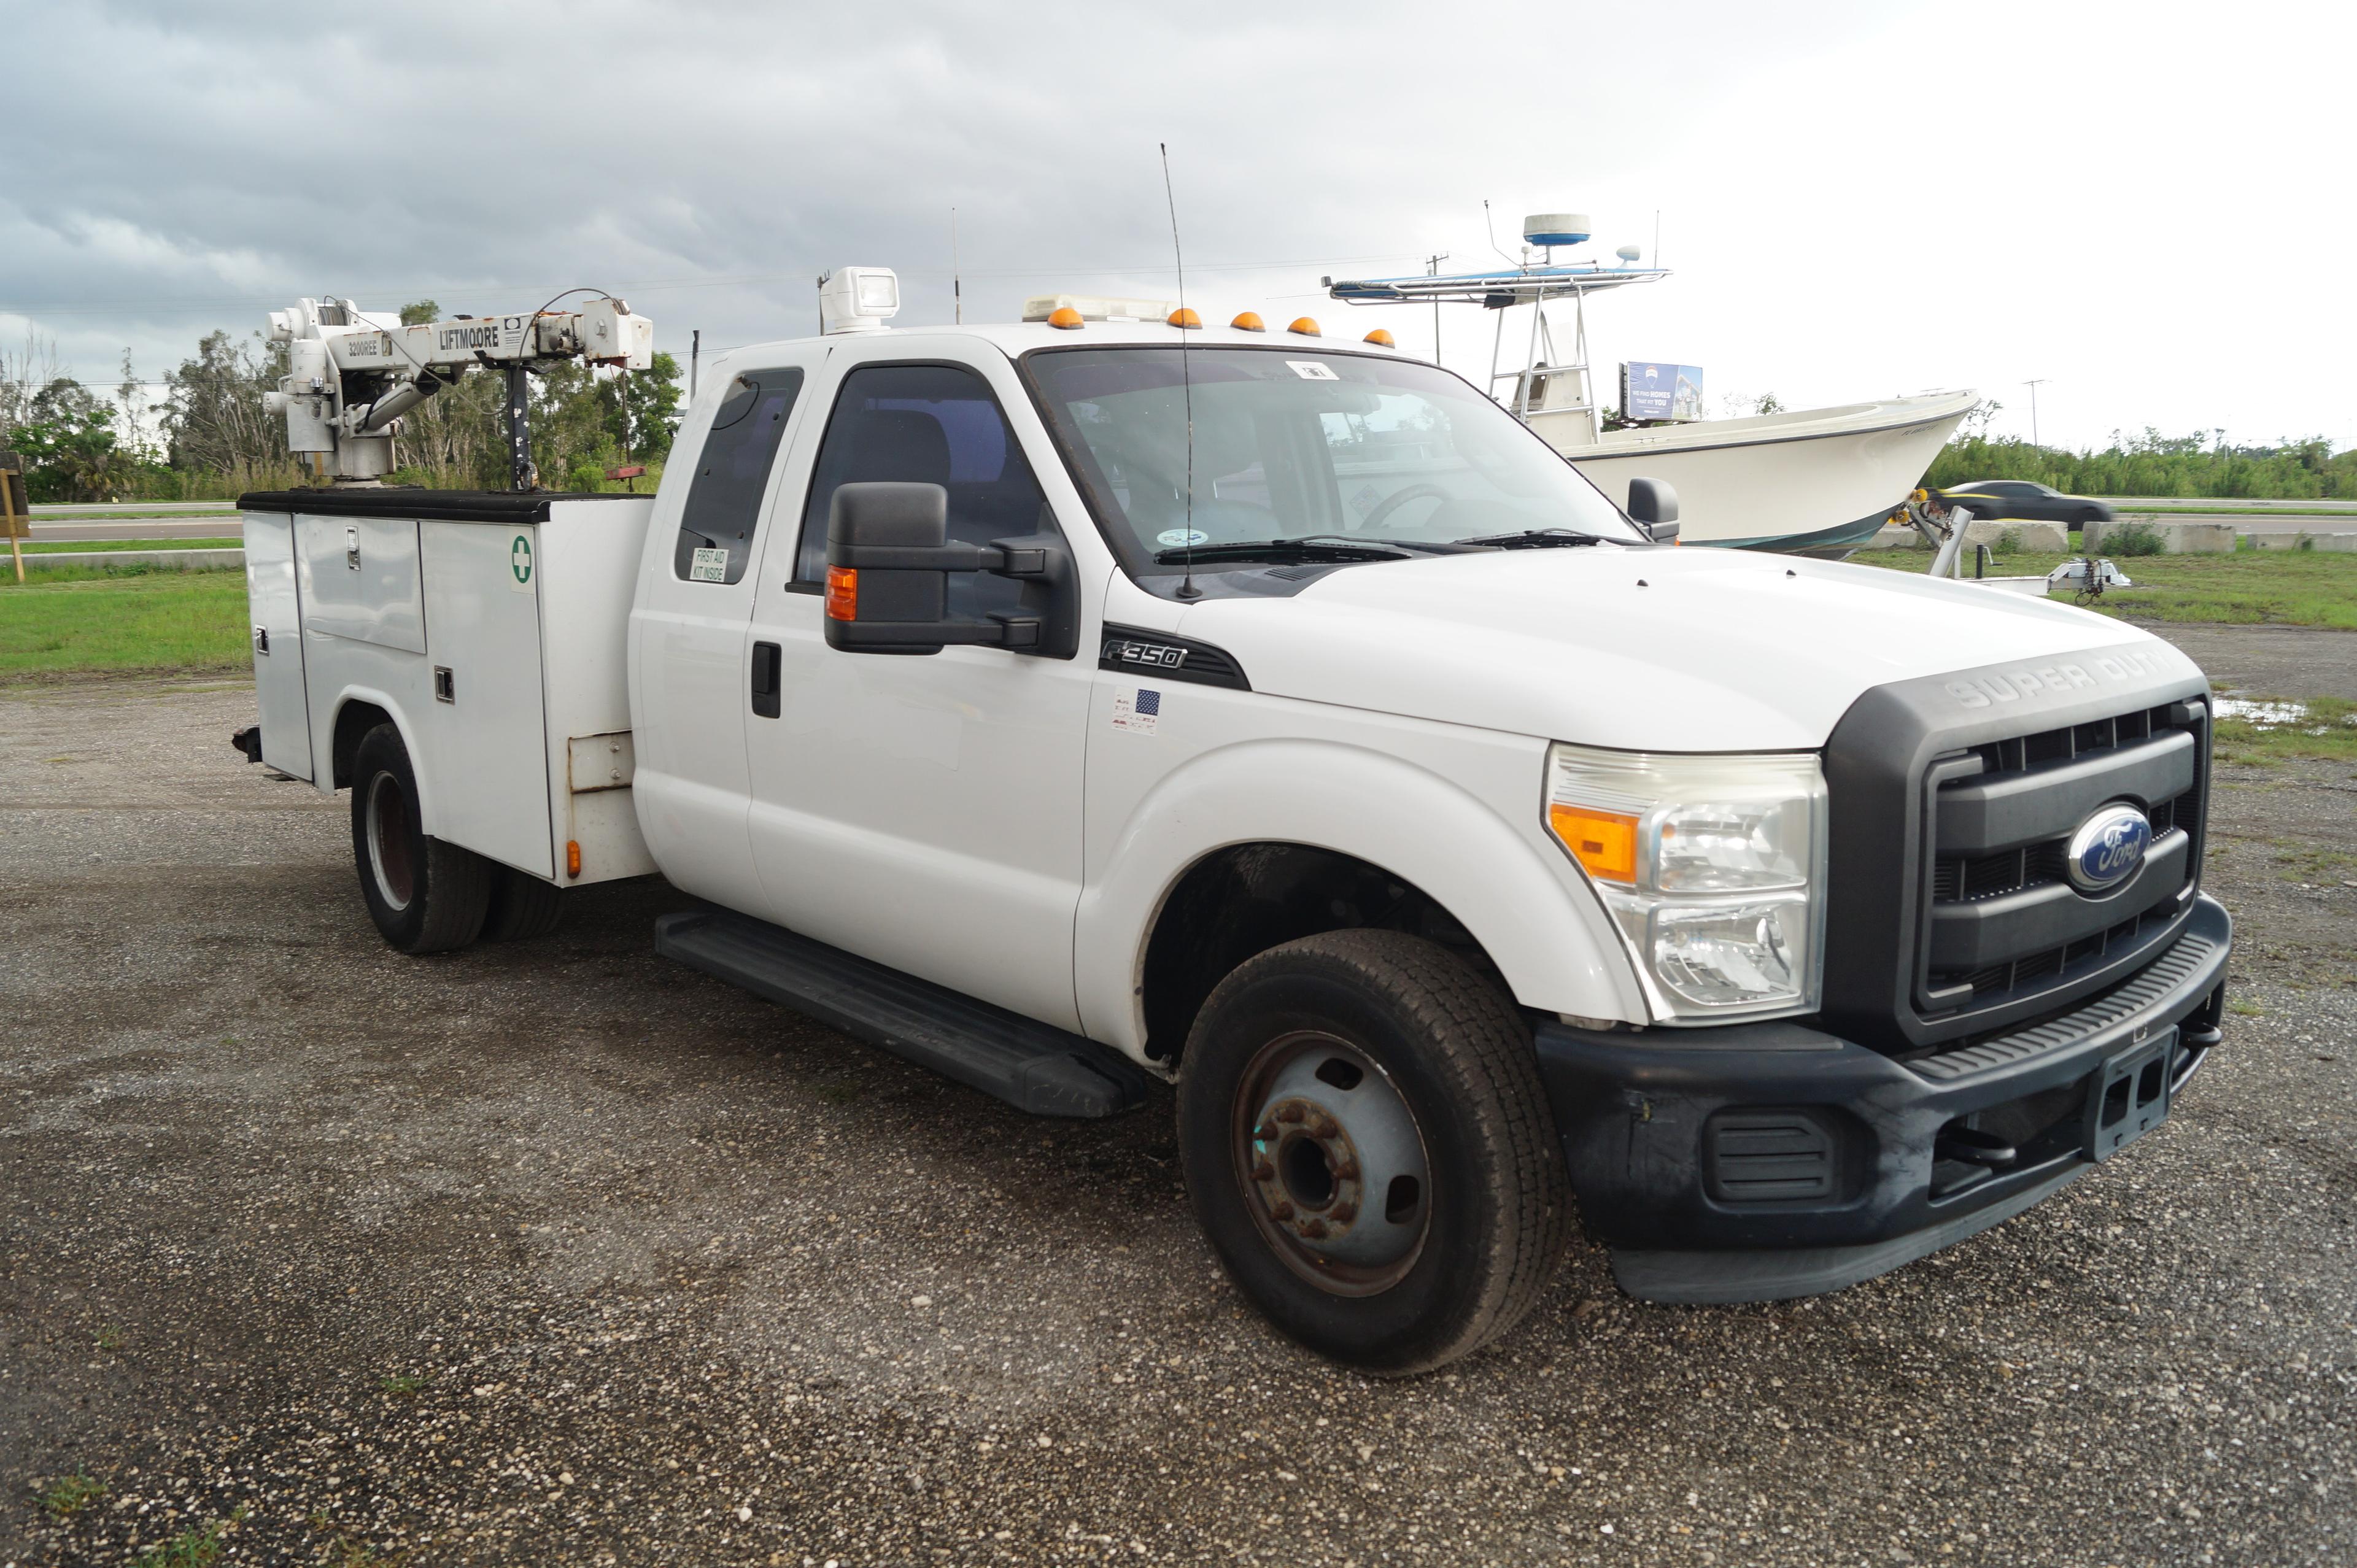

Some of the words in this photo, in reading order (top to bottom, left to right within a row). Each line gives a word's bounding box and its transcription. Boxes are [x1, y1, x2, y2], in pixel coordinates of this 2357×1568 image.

[439, 325, 499, 350] LIFTMOORE
[697, 549, 714, 563] FIRST
[714, 550, 724, 563] AID
[692, 565, 703, 579] KIT
[704, 566, 723, 581] INSIDE
[1945, 663, 2099, 709] SUPER
[2096, 648, 2174, 681] DUTY
[2098, 822, 2143, 872] Ford
